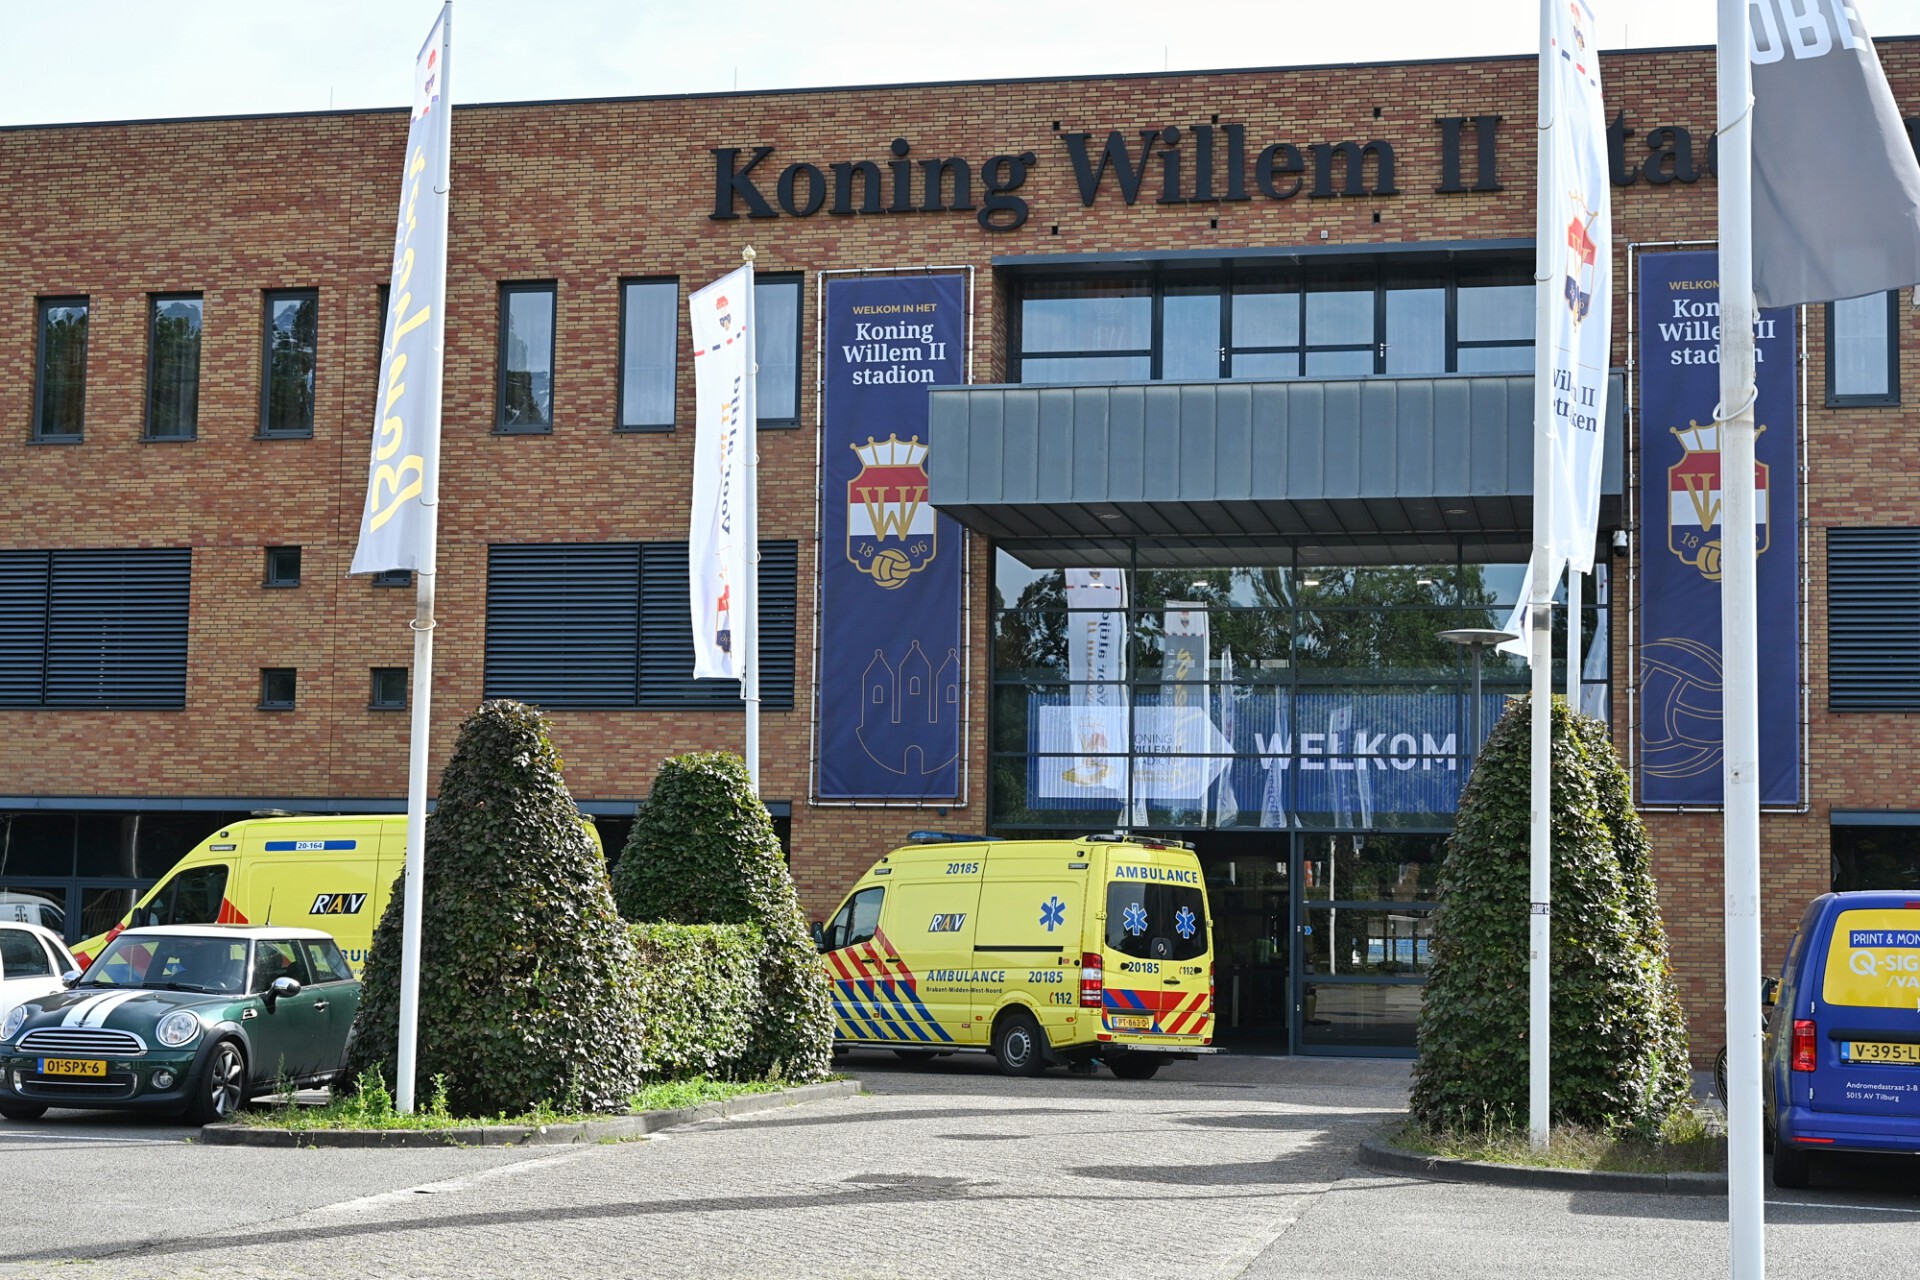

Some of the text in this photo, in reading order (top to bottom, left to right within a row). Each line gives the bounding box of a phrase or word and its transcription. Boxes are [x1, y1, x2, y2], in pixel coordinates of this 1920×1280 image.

[708, 115, 1503, 231] Koning Willem II
[852, 305, 901, 315] WELKOM
[916, 303, 937, 312] HET
[855, 320, 934, 343] Koning
[842, 342, 946, 363] Willem II
[852, 364, 935, 385] stadion
[857, 542, 874, 558] 18
[1254, 733, 1456, 771] WELKOM
[297, 841, 323, 849] 20-164
[946, 862, 979, 874] 20185
[1115, 865, 1198, 883] AMBULANCE
[309, 893, 367, 914] RAV
[928, 914, 966, 932] RAV
[1853, 933, 1884, 944] PRINT
[1886, 933, 1893, 944] &
[1128, 961, 1160, 974] 20185
[926, 970, 1063, 983] AMBULANCE 20185
[47, 1060, 100, 1074] 01-SPX-6
[1846, 1082, 1904, 1091] Andromedastraat
[1875, 1093, 1900, 1103] Tilburg
